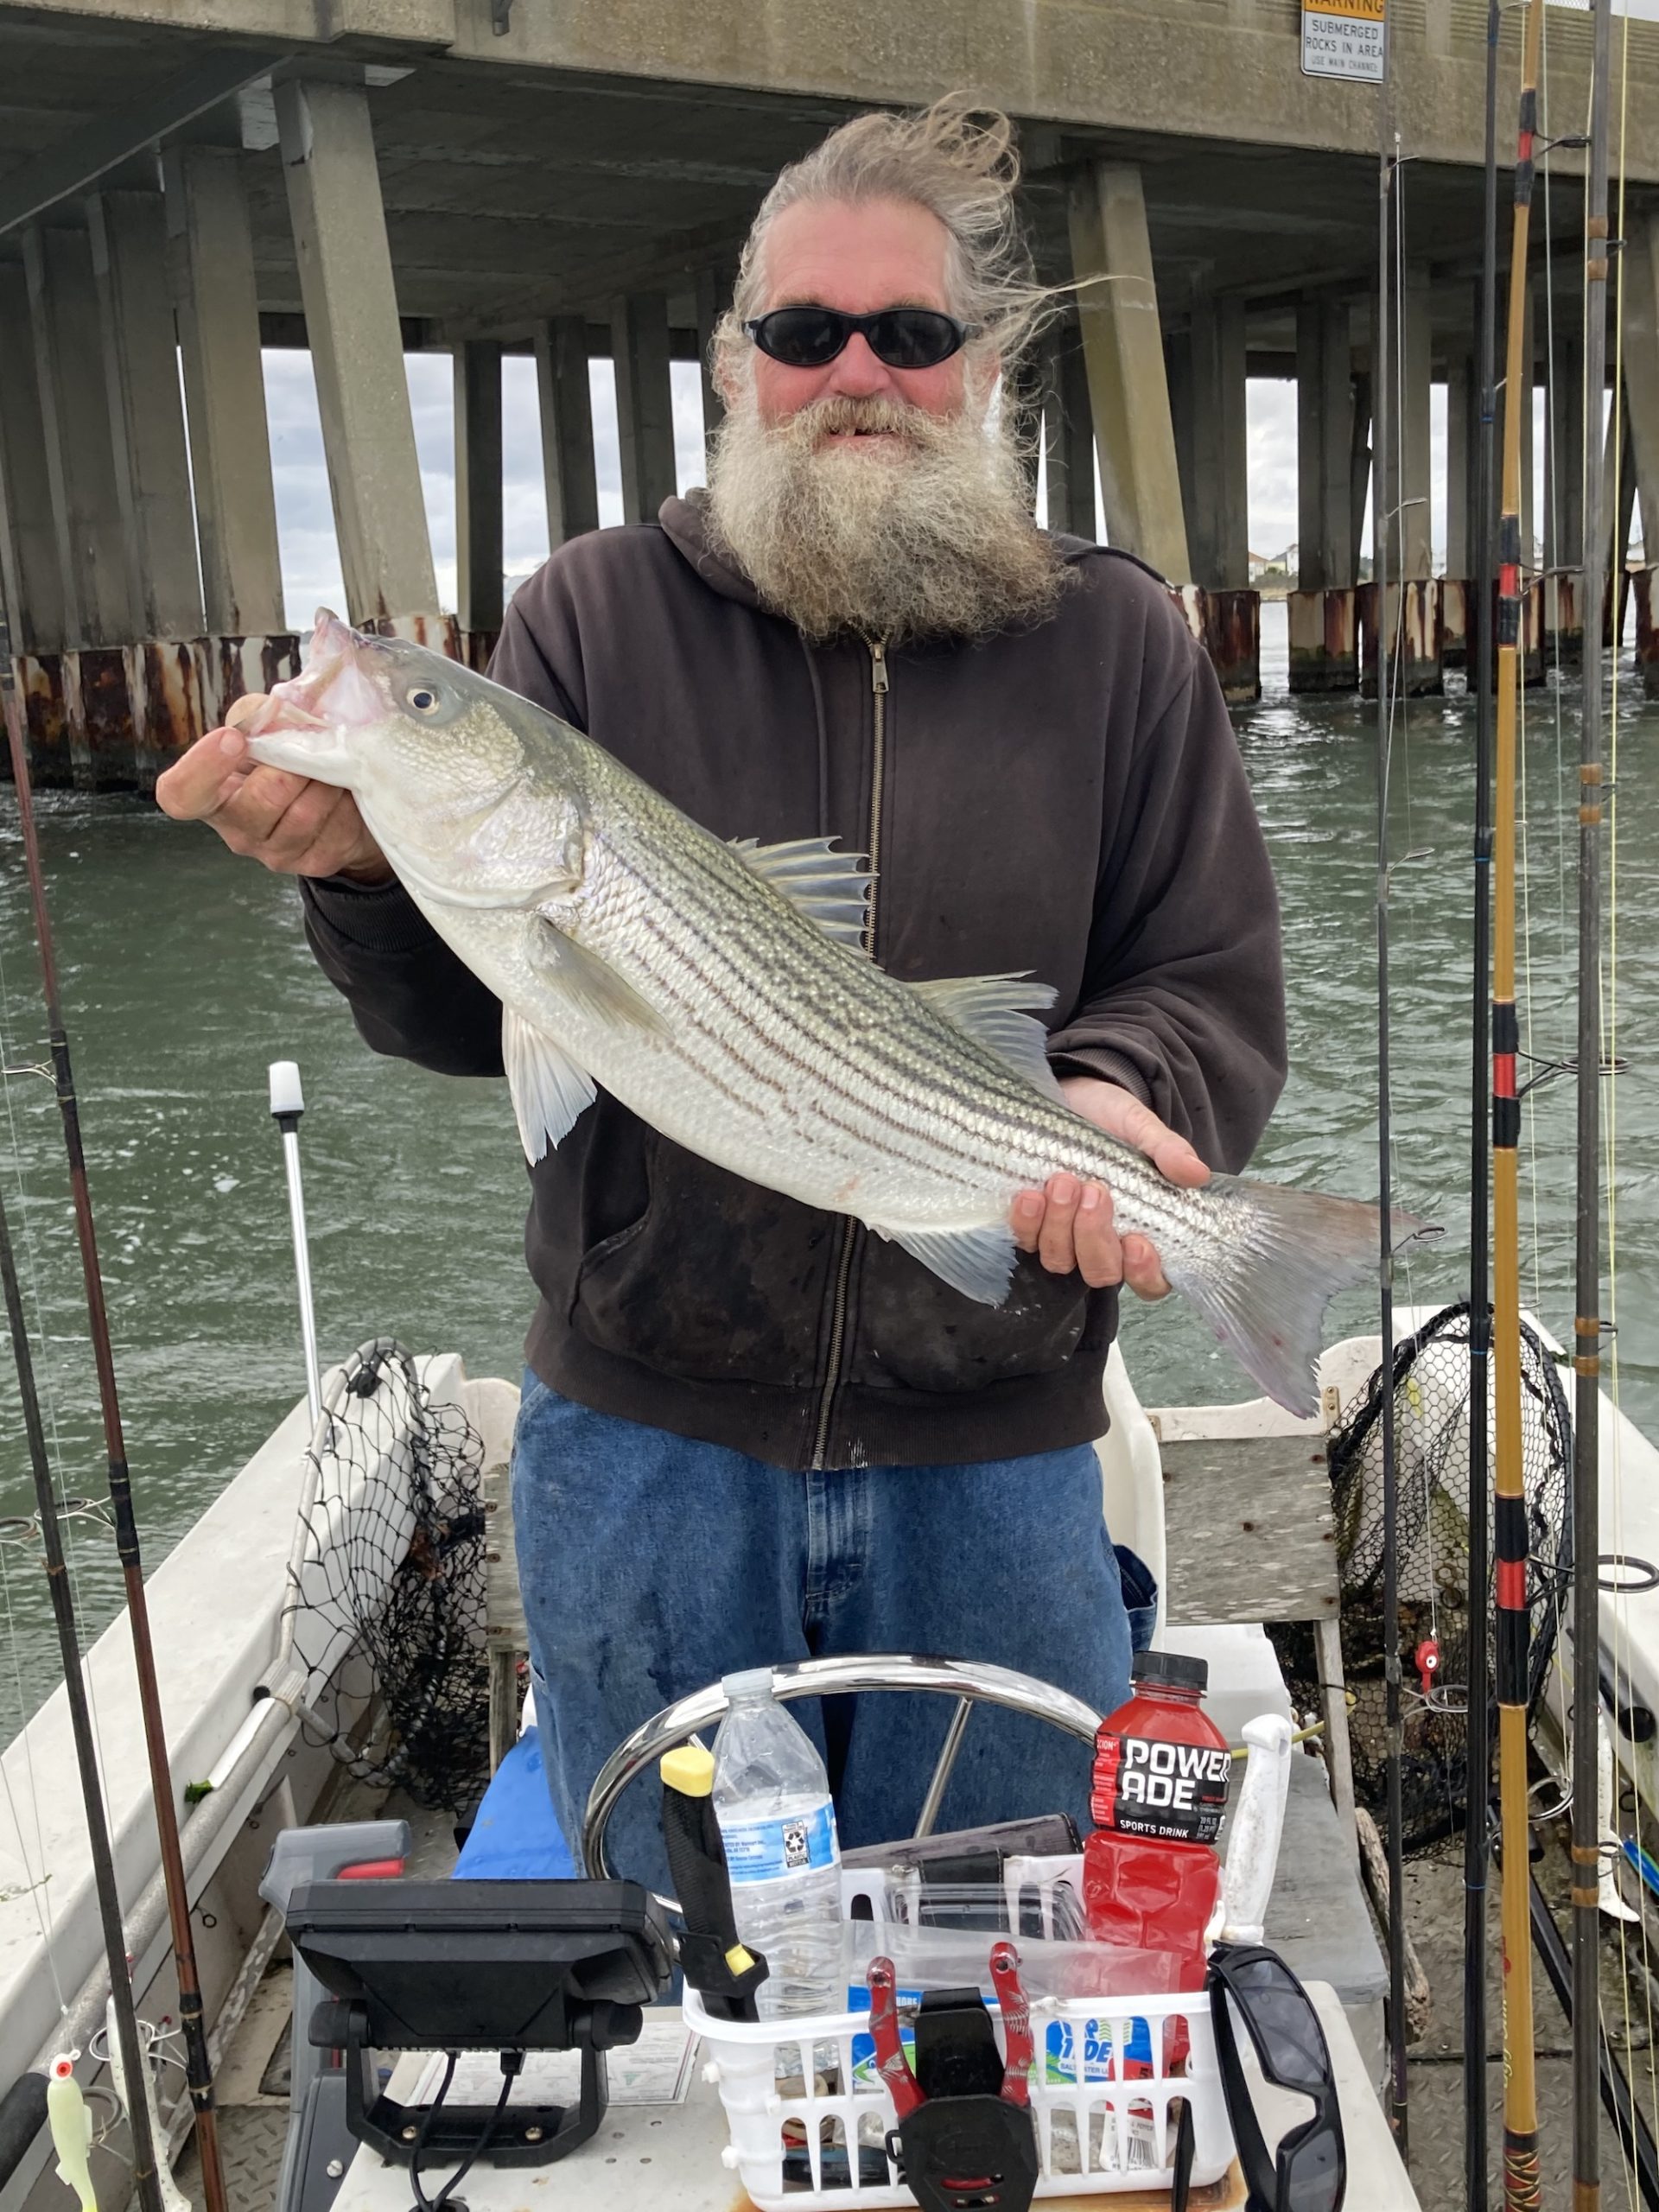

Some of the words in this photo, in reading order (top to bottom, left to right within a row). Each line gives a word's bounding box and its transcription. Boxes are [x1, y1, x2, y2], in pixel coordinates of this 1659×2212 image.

[1307, 0, 1384, 13] RNING
[1312, 19, 1378, 40] SUBMERGED
[1306, 36, 1337, 52] ROCKS
[1342, 41, 1352, 54] IN
[1357, 44, 1383, 58] AREA
[1312, 55, 1325, 66] USE
[1328, 58, 1344, 67] MAIN
[1124, 1738, 1231, 1782] POWER
[1122, 1770, 1196, 1810] ADE
[1120, 1819, 1156, 1834] SPORTS
[1159, 1826, 1189, 1839] DRINK
[1061, 2037, 1112, 2063] TDE
[1060, 2062, 1100, 2074] SALATER
